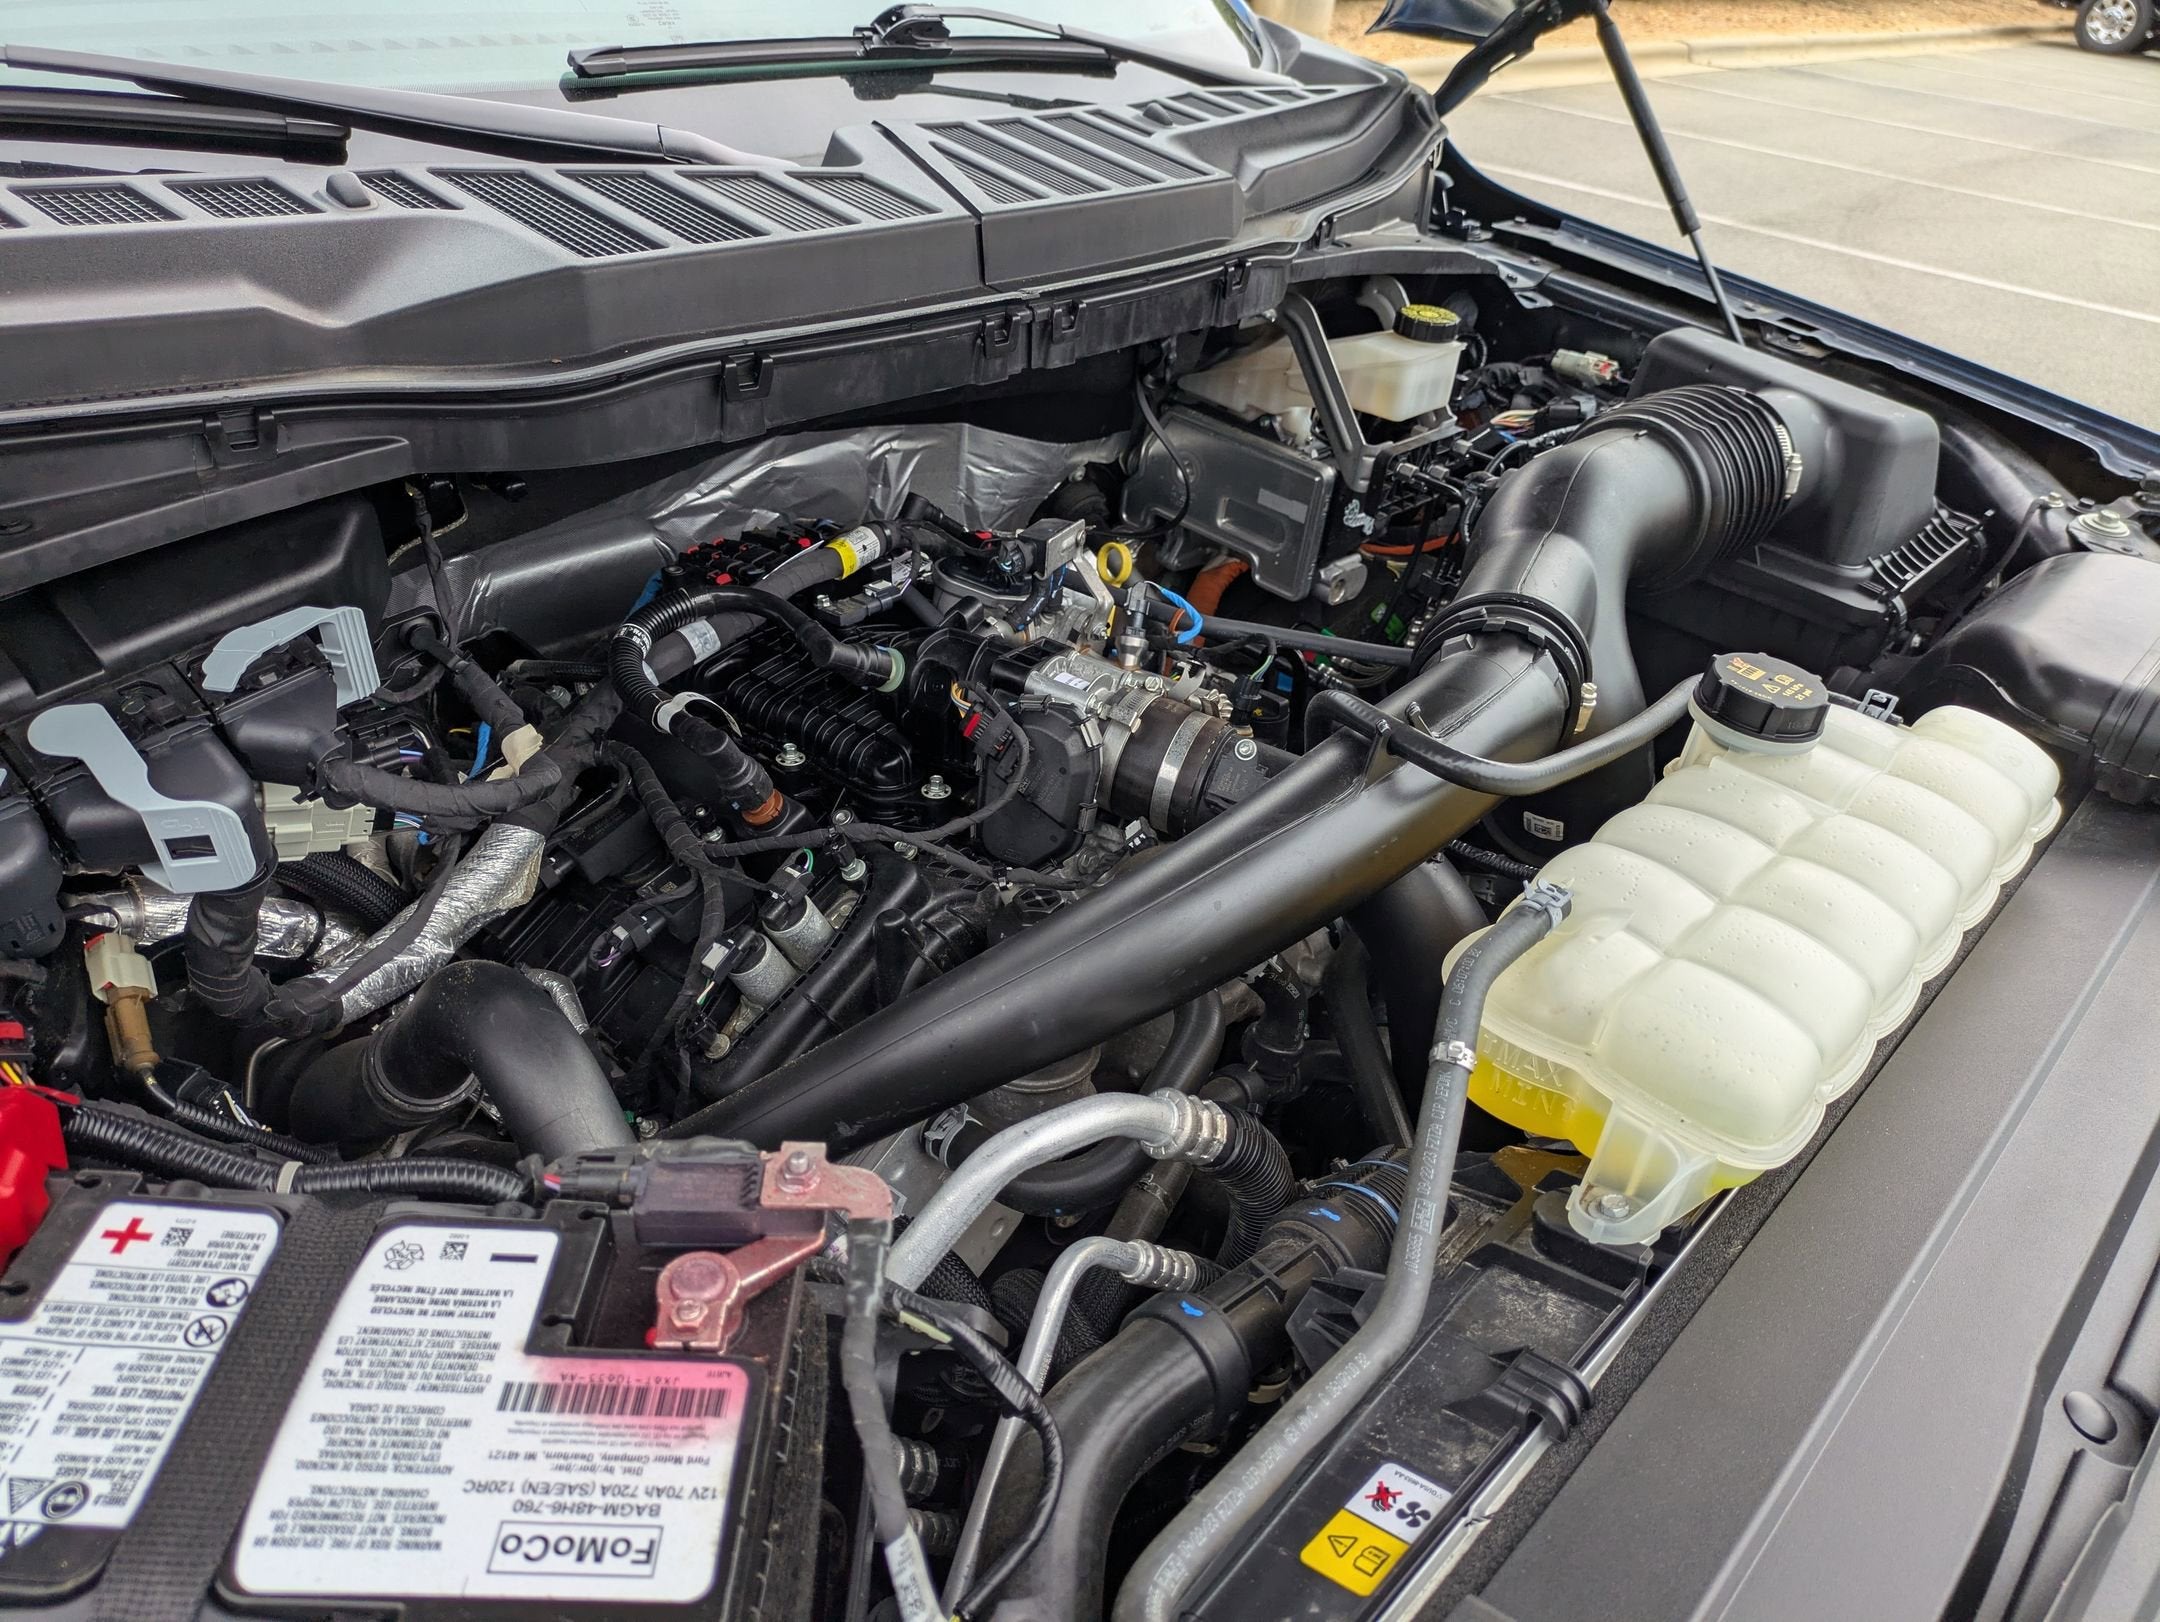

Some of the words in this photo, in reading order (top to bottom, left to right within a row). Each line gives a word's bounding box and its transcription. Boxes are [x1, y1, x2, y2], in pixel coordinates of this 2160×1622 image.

[1497, 1043, 1562, 1086] MAX
[1489, 1069, 1556, 1115] MIN
[438, 1286, 458, 1295] DOIT
[460, 1288, 501, 1297] BATTERIE
[502, 1289, 514, 1297] LA
[373, 1295, 426, 1306] RECICLARSE
[428, 1297, 450, 1306] DEBE
[490, 1299, 502, 1308] LA
[370, 1306, 416, 1316] RECYCLED
[417, 1308, 428, 1316] BE
[430, 1308, 455, 1318] MUST
[457, 1309, 496, 1319] BATTERY
[523, 1452, 538, 1460] MI
[653, 1454, 684, 1464] Motor
[687, 1455, 710, 1465] Ford
[462, 1480, 515, 1494] 120RC
[521, 1480, 596, 1497] (SAE/EN)
[600, 1484, 639, 1497] 720A
[644, 1484, 684, 1498] 70Ah
[691, 1486, 718, 1500] 12V
[512, 1499, 661, 1517] BAGM-48H6-760
[500, 1533, 657, 1565] FoMoCo
